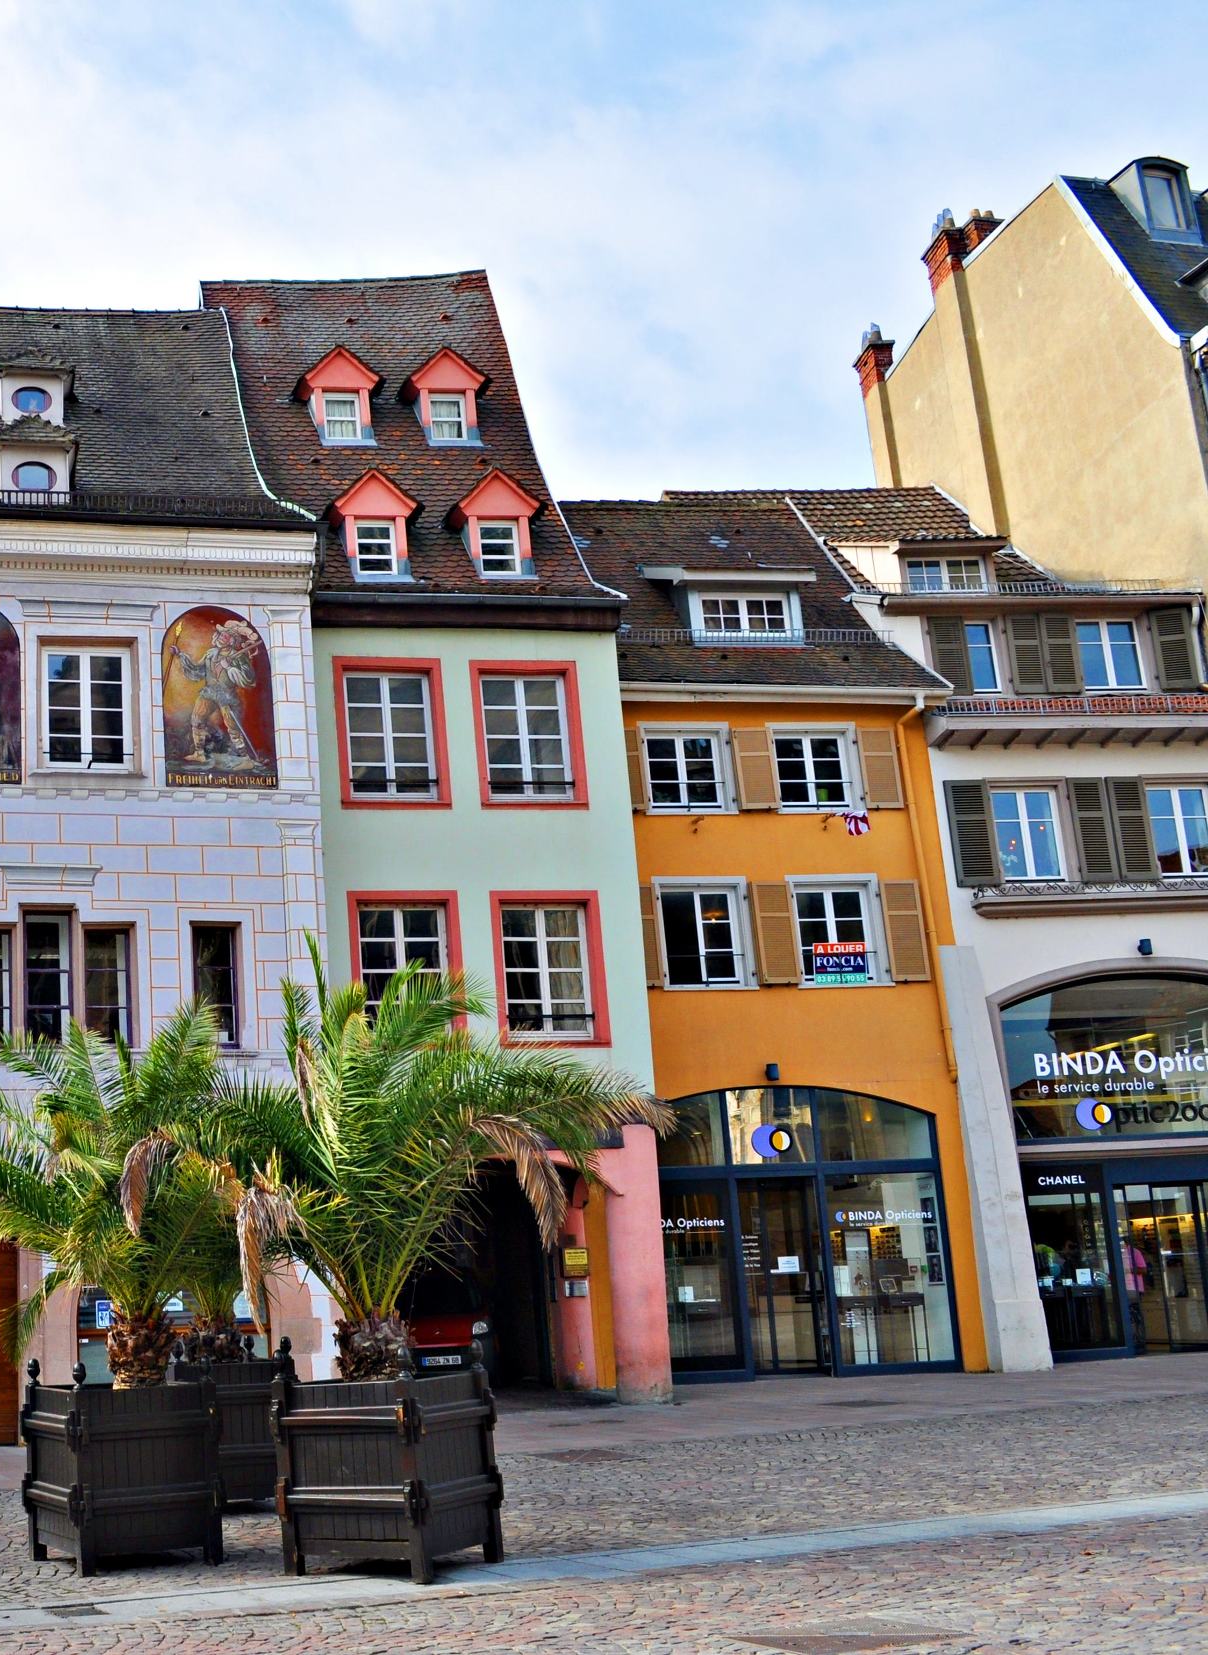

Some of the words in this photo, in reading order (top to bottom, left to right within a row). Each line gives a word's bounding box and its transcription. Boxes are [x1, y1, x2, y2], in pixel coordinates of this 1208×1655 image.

[816, 945, 825, 954] A
[827, 944, 864, 953] LOUER
[816, 956, 864, 966] FONCIA
[1033, 1050, 1126, 1077] BINDA
[1037, 1080, 1049, 1094] le
[1054, 1082, 1100, 1093] service
[1104, 1078, 1155, 1092] durable
[1038, 1174, 1086, 1186] CHANEL
[848, 1210, 883, 1221] BINDA
[885, 1209, 933, 1221] Opticiens
[677, 1217, 725, 1229] Opticiens
